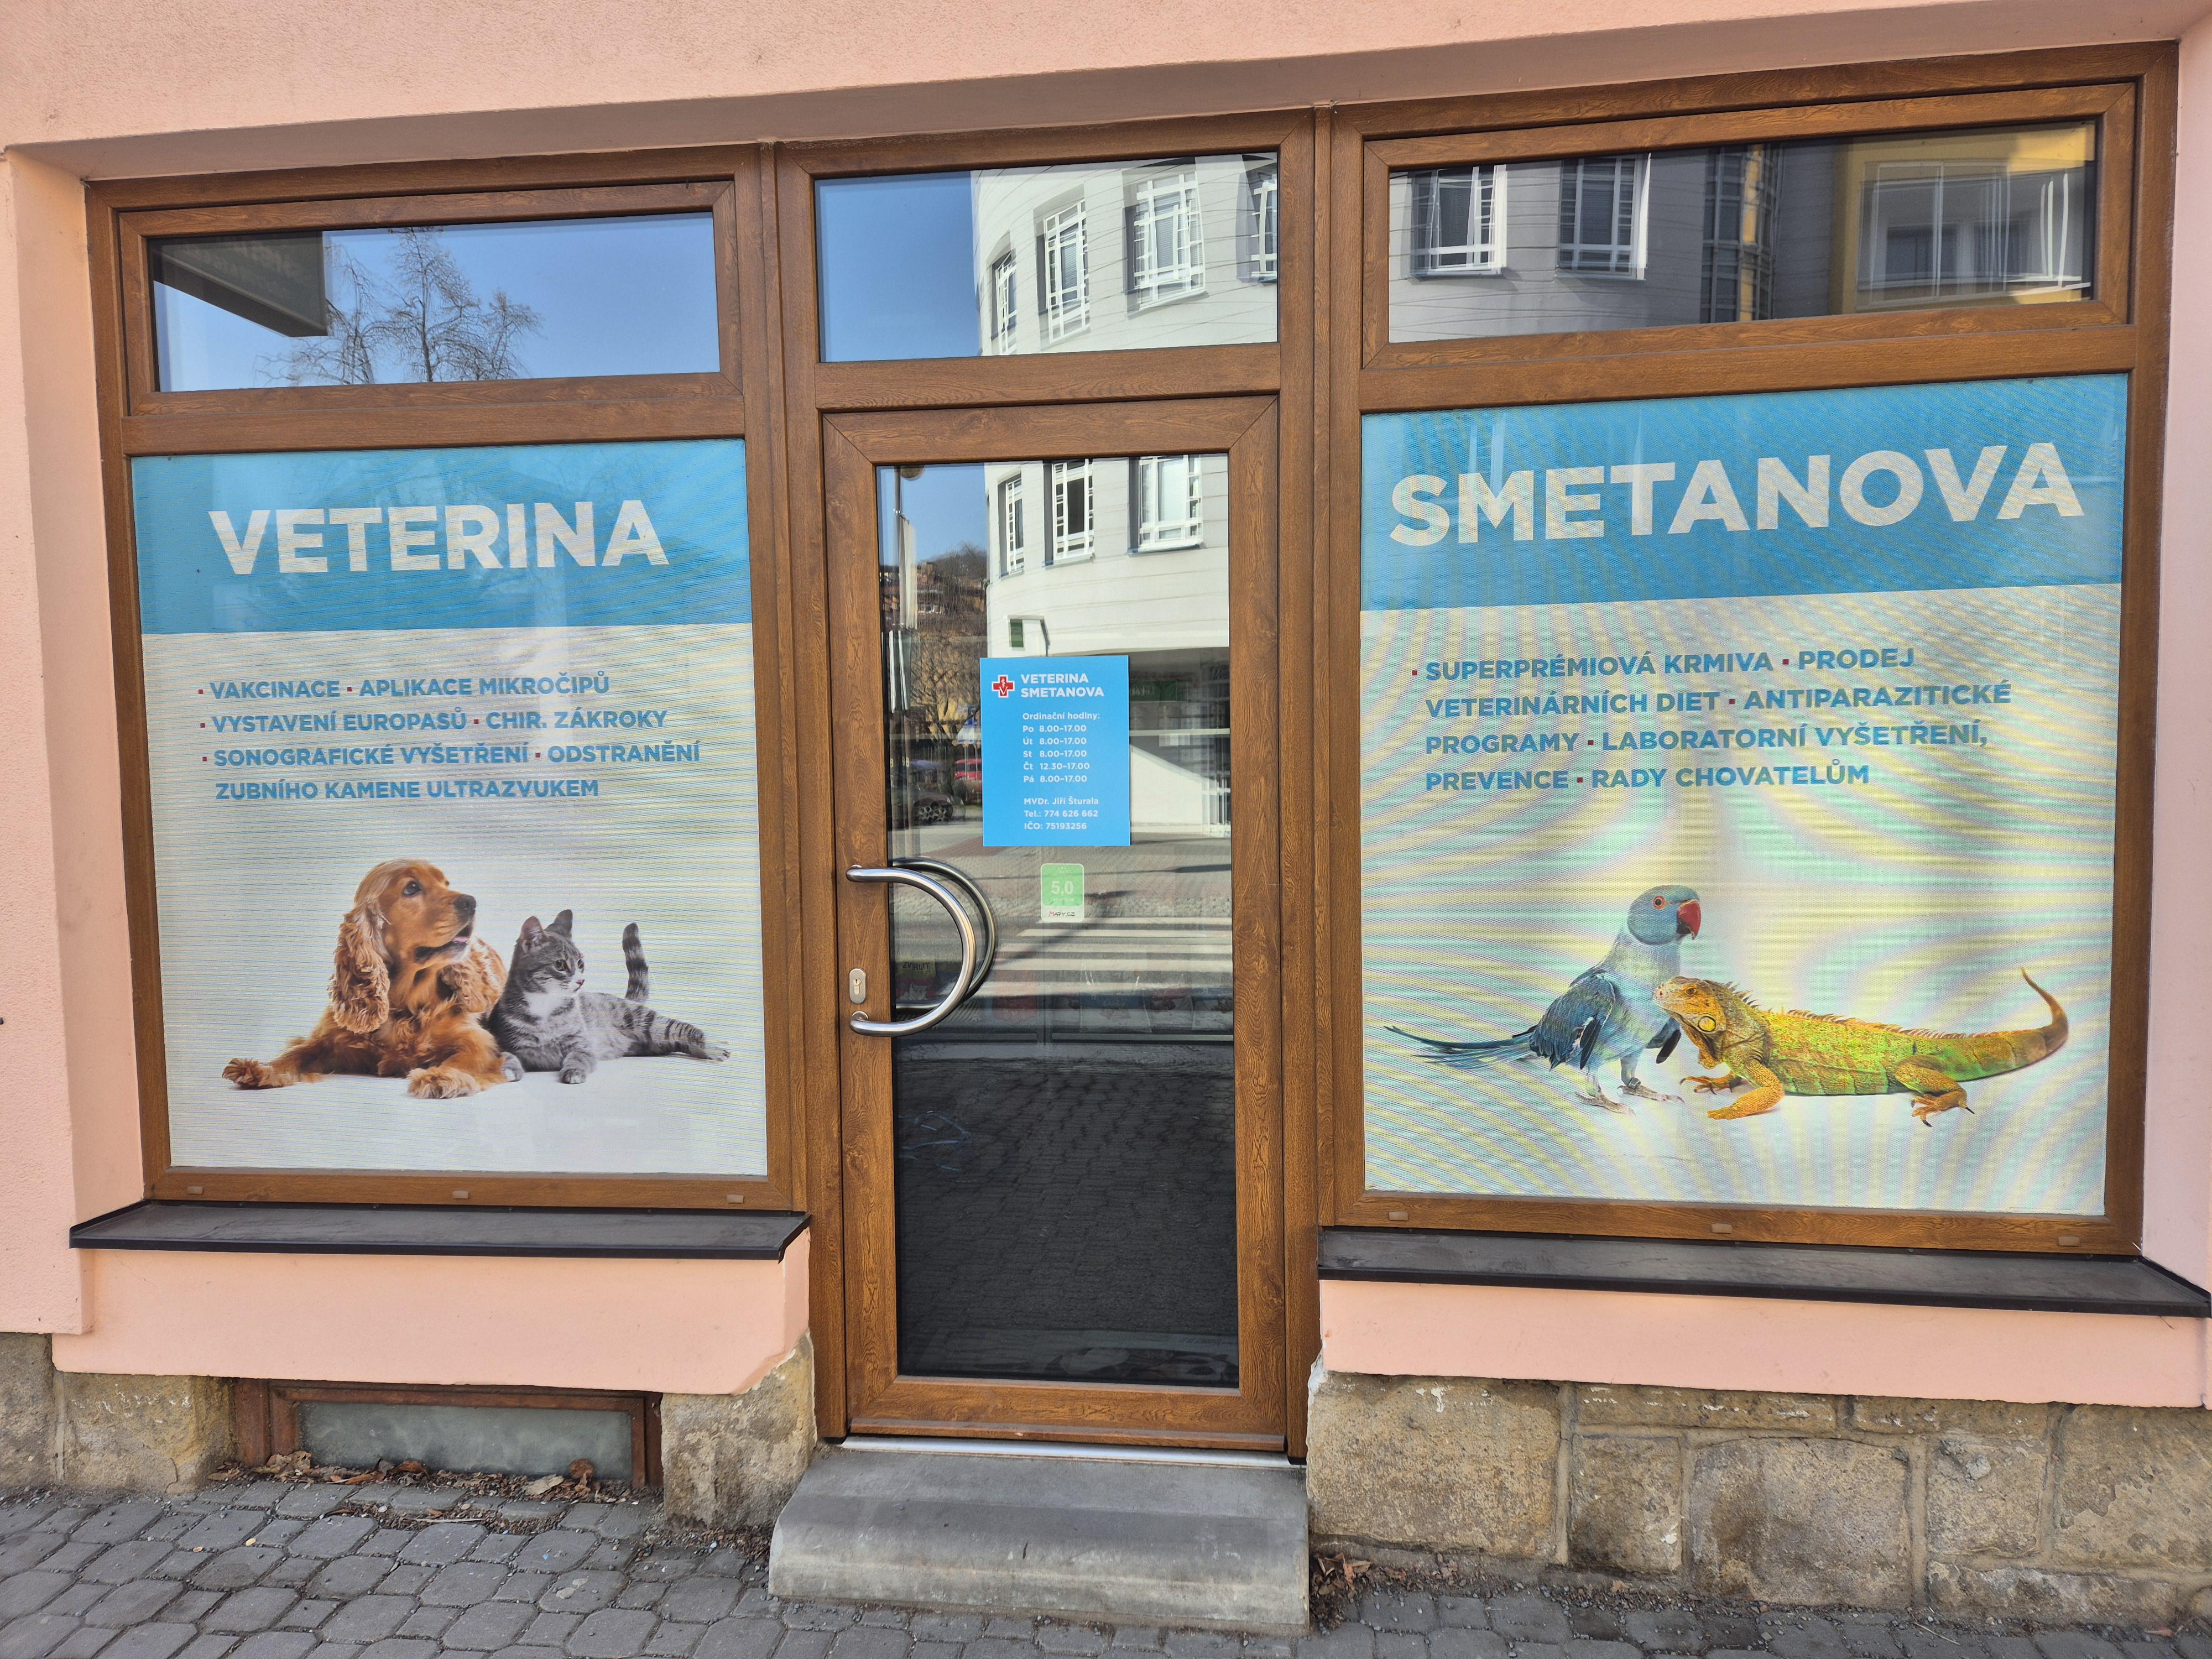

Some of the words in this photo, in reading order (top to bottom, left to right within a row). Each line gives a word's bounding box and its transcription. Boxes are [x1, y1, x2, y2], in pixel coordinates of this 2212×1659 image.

[1388, 442, 2085, 546] SMETANOVA
[208, 499, 670, 575] VETERINA
[1426, 650, 1655, 680] SUPERPRÉMIOVÁ
[1664, 653, 1773, 674] KRMIVA
[1798, 648, 1914, 670] PRODEJ
[209, 680, 340, 699] VAKCINACE
[359, 678, 472, 697] APLIKACE
[479, 671, 609, 695] MIKROČIPŮ
[1020, 673, 1088, 684] VETERINA
[1021, 687, 1105, 697] SMETANOVA
[1426, 690, 1647, 717] VETERINÁRNÍCH
[1657, 691, 1720, 712] DIET
[1744, 680, 2011, 709] ANTIPARAZITICKÉ
[211, 709, 337, 732] VYSTAVENÍ
[343, 707, 466, 731] EUROPASŮ
[486, 712, 547, 729] CHIR.
[554, 707, 667, 728] ZÁKROKY
[1022, 737, 1033, 745] Út
[1426, 732, 1579, 754] PROGRAMY
[1603, 723, 1807, 751] LABORATORNÍ
[1815, 719, 1988, 747] VYŠETŘENÍ,
[213, 744, 394, 766] SONOGRAFICKÉ
[400, 742, 529, 764] VYŠETŘENÍ
[548, 740, 701, 763] ODSTRANĚNÍ
[1023, 761, 1034, 770] Čt
[1426, 771, 1568, 790] PREVENCE
[1592, 769, 1667, 789] RADY
[1675, 758, 1869, 787] CHOVATELŮM
[216, 779, 318, 800] ZUBNÍHO
[325, 781, 420, 799] KAMENE
[427, 780, 598, 798] ULTRAZVUKEM
[1024, 821, 1043, 830] IČO:
[1051, 880, 1073, 897] 5,0
